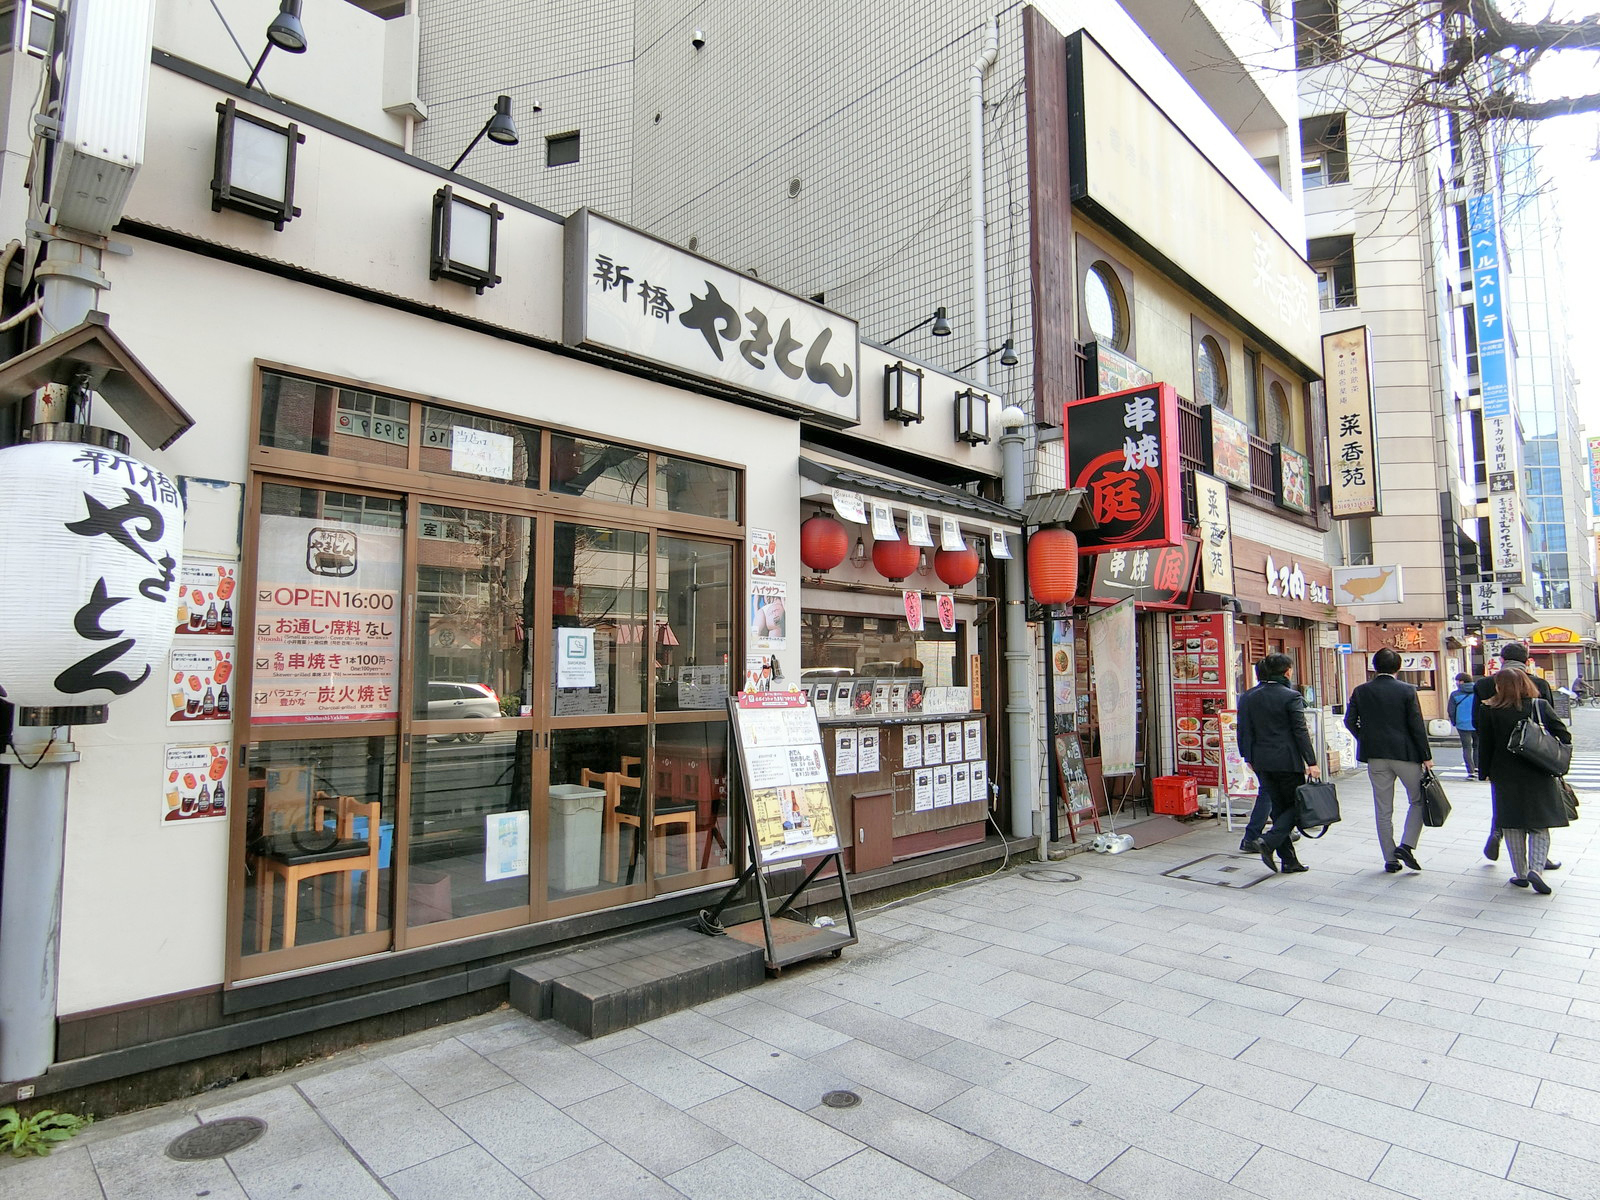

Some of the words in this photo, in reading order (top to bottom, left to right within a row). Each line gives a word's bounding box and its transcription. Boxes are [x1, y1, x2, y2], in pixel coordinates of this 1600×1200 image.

[1476, 239, 1498, 328] ヘルスリテ
[593, 253, 675, 325] 新橋
[679, 279, 853, 398] やきとん
[1123, 396, 1159, 472] 串焼
[1339, 413, 1366, 488] 菜香苑
[1493, 418, 1508, 472] 牛カツ専門店
[72, 449, 178, 509] 新橋
[1091, 470, 1142, 524] 庭
[54, 487, 177, 696] やきとん
[274, 587, 341, 608] OPEN
[343, 592, 394, 610] 16:00
[752, 585, 785, 596] ハイサワー
[1478, 583, 1497, 614] 勝牛
[365, 622, 392, 636] なし
[288, 653, 342, 670] 串焼き
[280, 698, 306, 707] 豊かな
[317, 685, 392, 703] 炭火焼き
